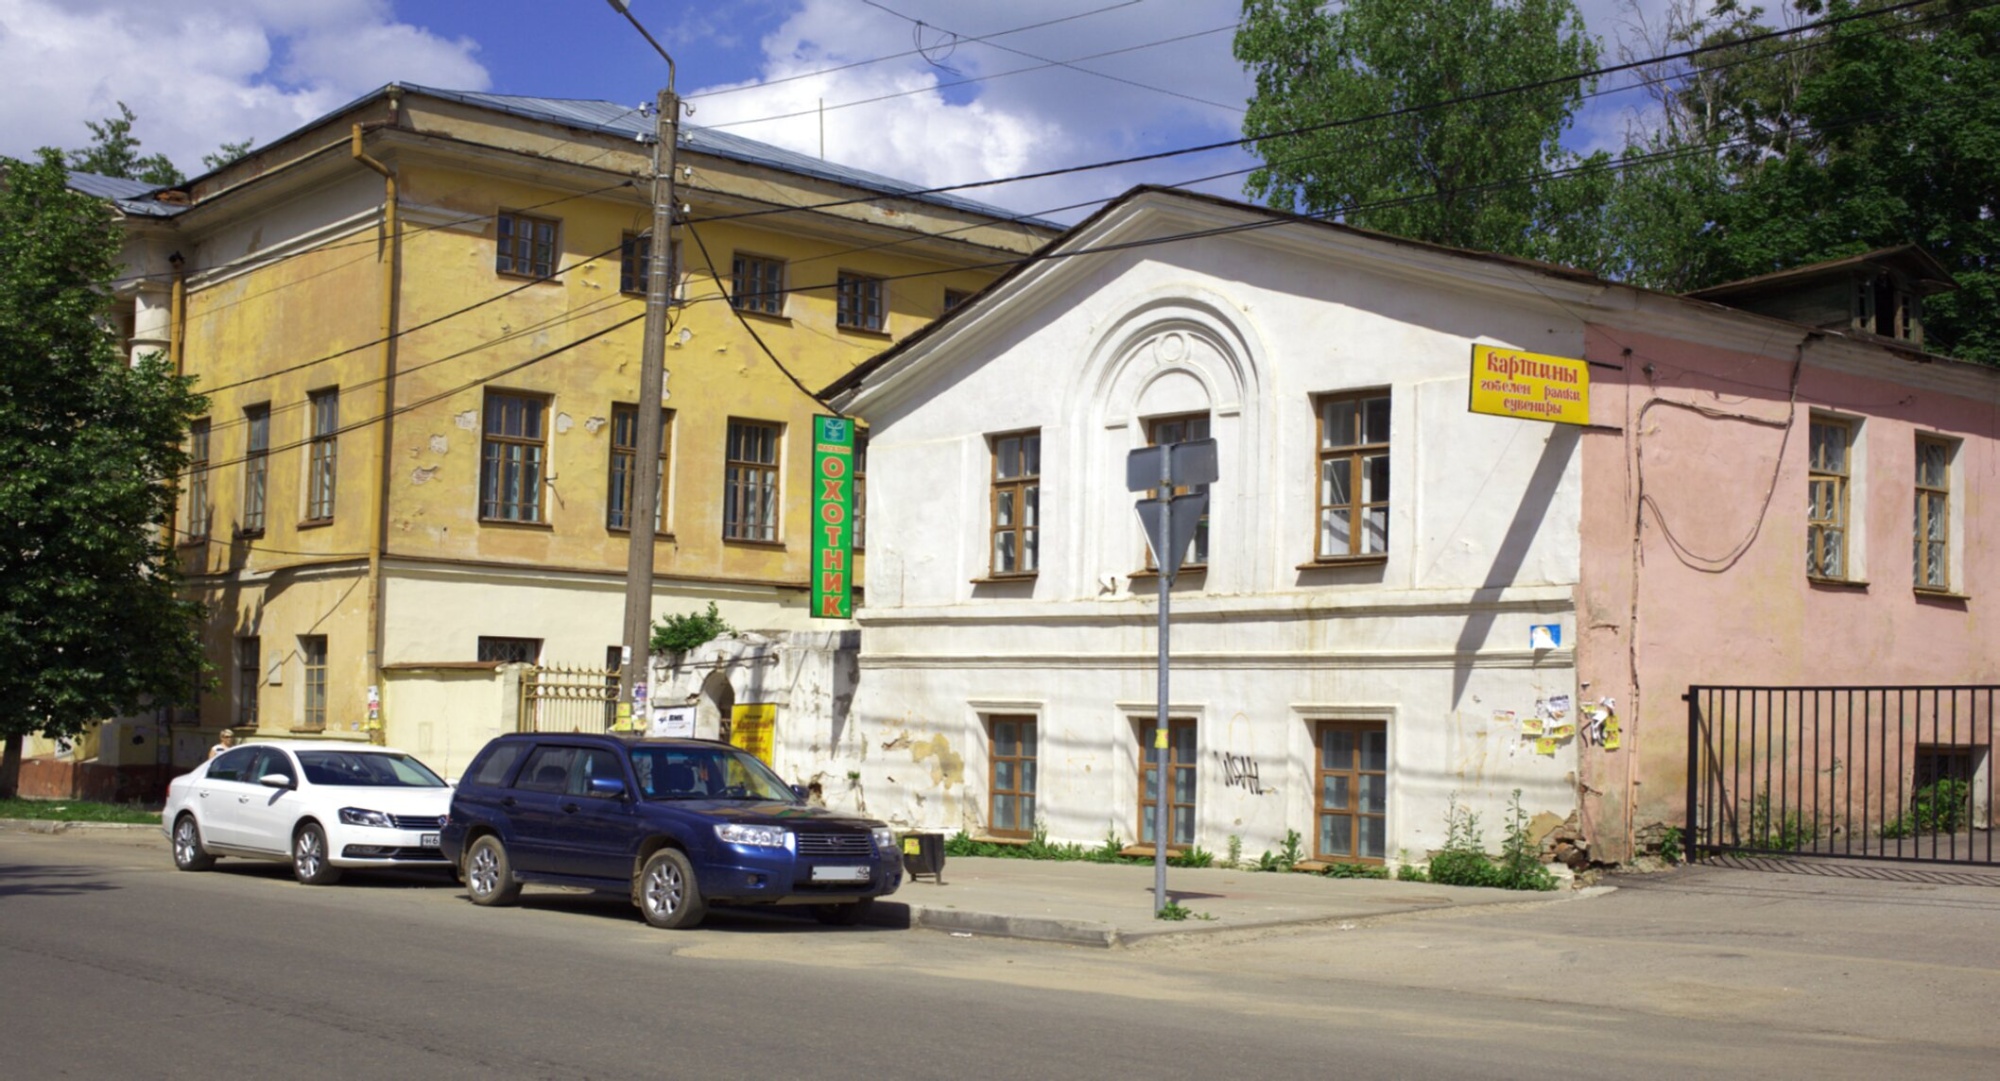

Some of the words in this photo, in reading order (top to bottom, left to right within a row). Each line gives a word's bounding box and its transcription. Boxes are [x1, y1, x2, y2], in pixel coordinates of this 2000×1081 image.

[1481, 379, 1532, 395] гобелен
[1544, 384, 1581, 402] рамки
[1503, 397, 1562, 416] сувениры
[821, 457, 845, 617] ОХОТНИК
